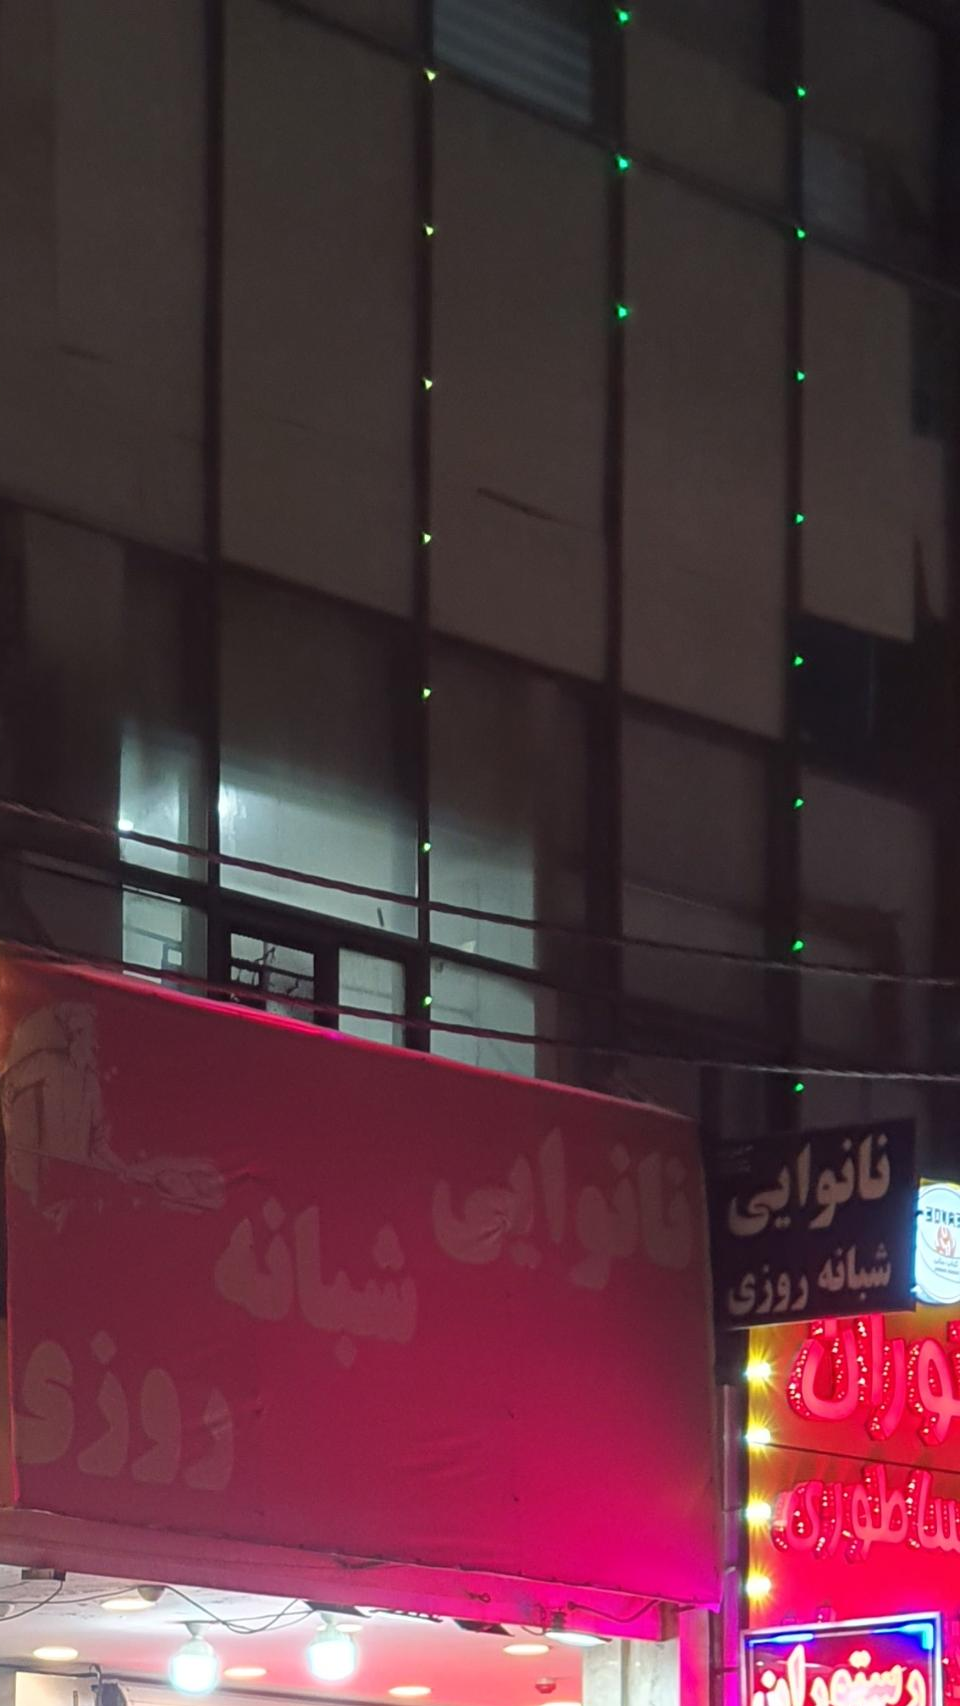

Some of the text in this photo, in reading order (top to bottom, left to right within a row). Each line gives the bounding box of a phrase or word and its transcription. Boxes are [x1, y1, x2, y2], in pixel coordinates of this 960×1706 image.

[432, 1126, 694, 1288] نانوایی
[728, 1133, 891, 1236] نانوایی
[214, 1197, 419, 1370] شبانه
[727, 1243, 892, 1315] شبانه روزی
[16, 1330, 236, 1492] روزی
